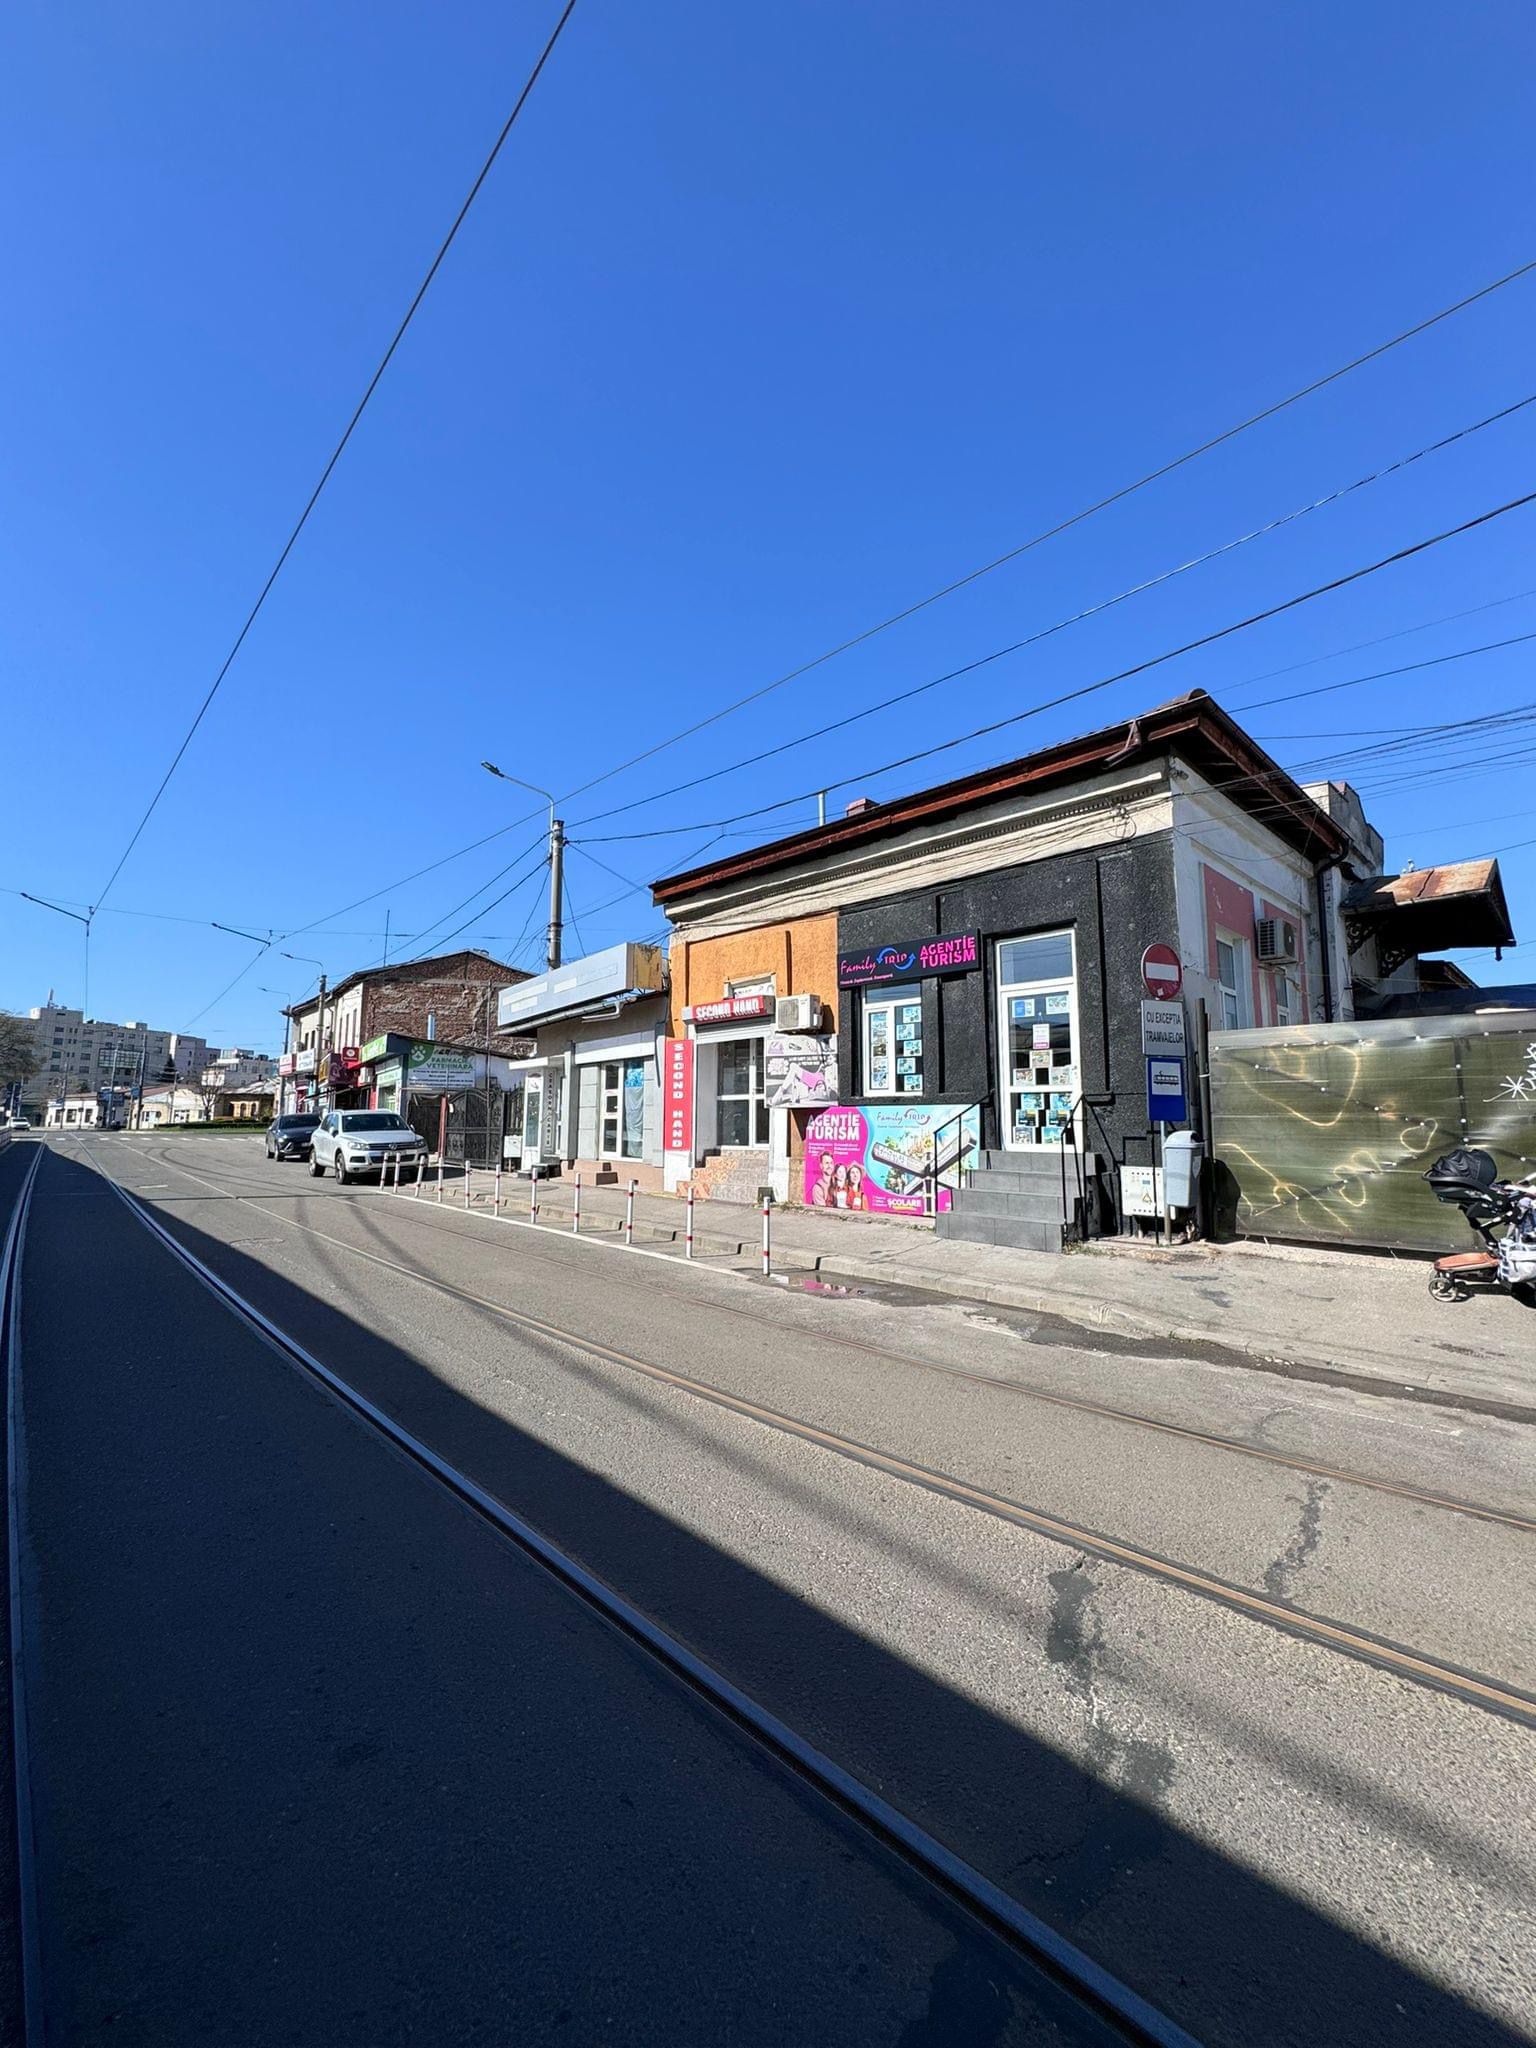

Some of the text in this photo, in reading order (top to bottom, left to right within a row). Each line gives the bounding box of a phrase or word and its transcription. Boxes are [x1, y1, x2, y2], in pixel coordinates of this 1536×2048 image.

[840, 955, 876, 975] Family
[920, 948, 976, 968] TURISM
[695, 998, 760, 1021] SECOND HAND
[672, 1043, 685, 1147] SECOND HAND
[877, 1111, 903, 1125] Family
[806, 1126, 860, 1141] TURISM
